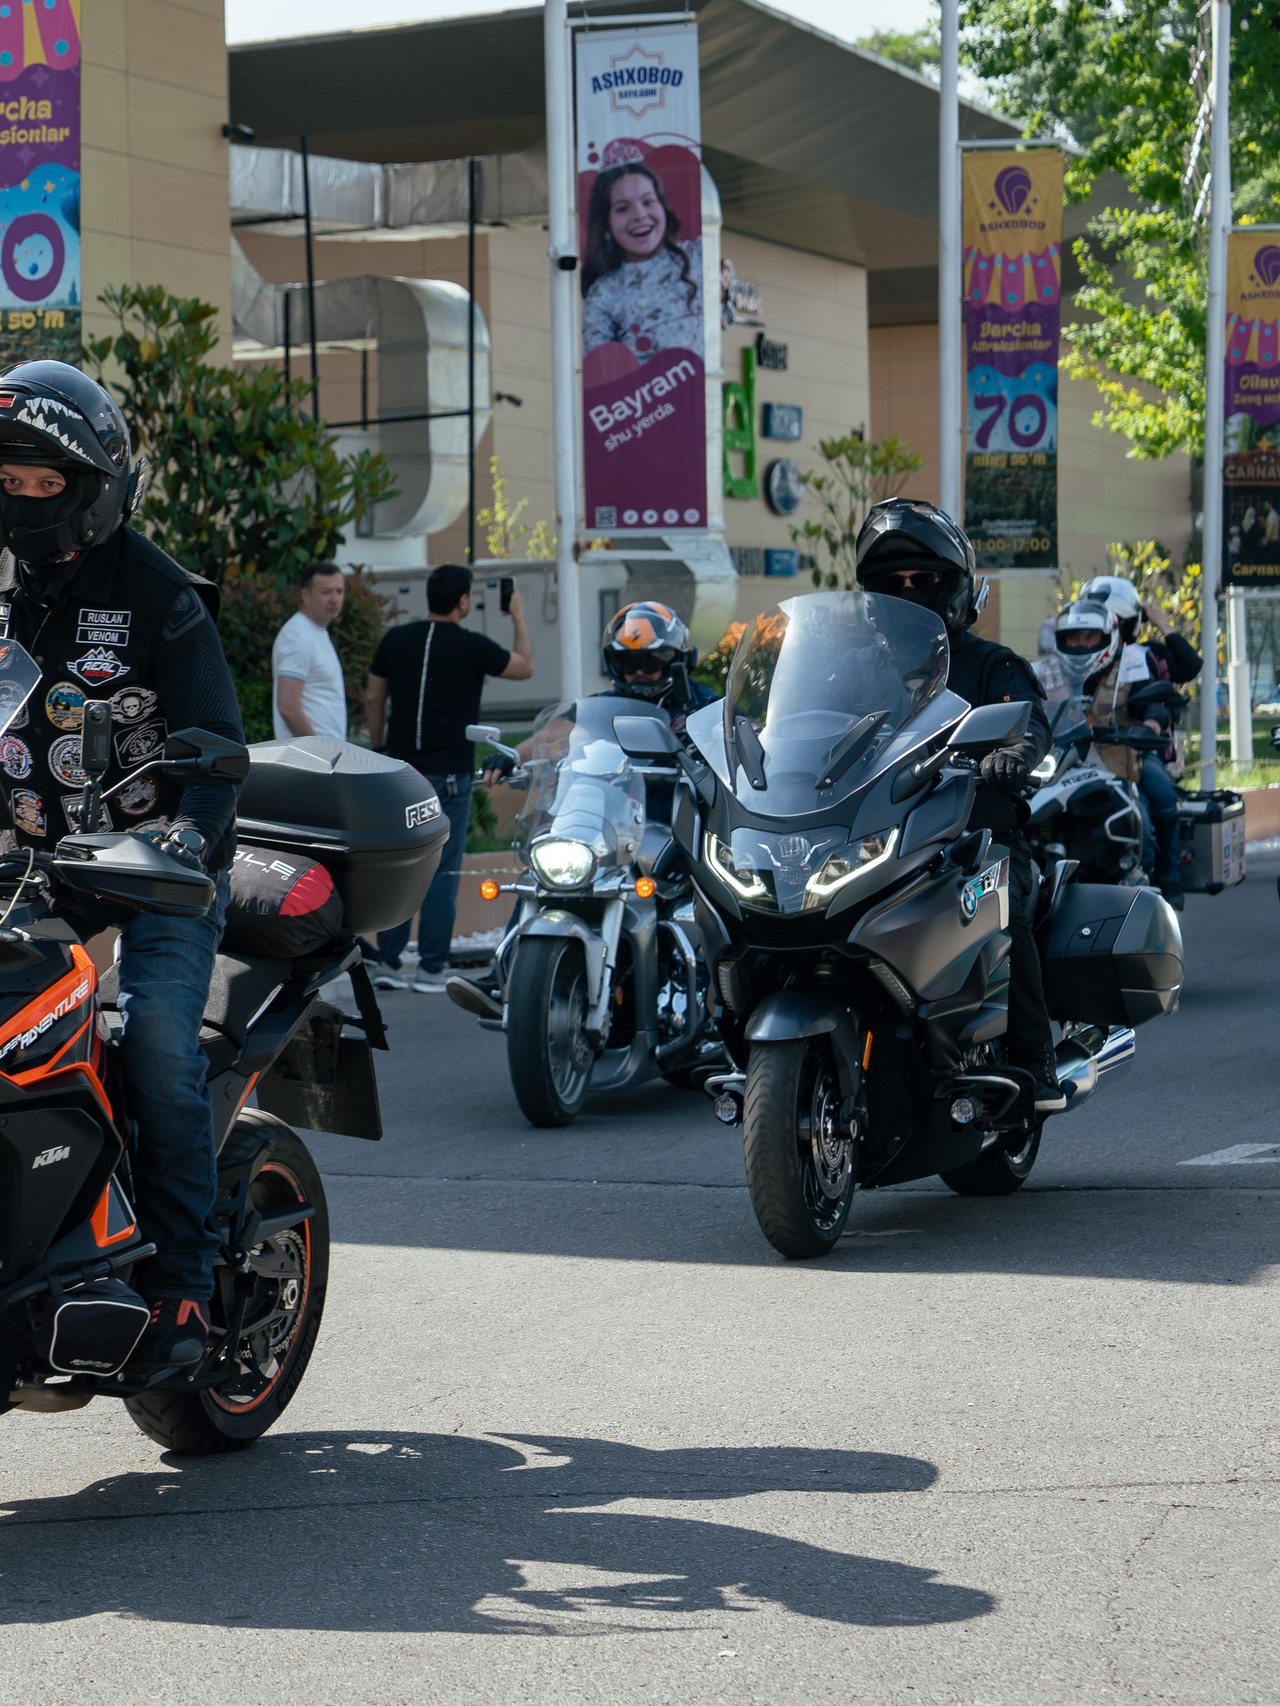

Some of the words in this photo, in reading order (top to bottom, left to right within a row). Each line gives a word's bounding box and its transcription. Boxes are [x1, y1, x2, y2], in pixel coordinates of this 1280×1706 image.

[591, 66, 683, 95] ASHXOBOD
[980, 320, 1042, 340] Barcha
[588, 359, 696, 433] Bayram
[604, 428, 633, 452] shu
[632, 402, 676, 438] yerda
[974, 392, 1047, 450] 70
[87, 612, 123, 624] RUSLAN
[87, 630, 119, 643] VENOM
[20, 979, 89, 1050] ADVENTURE
[32, 1145, 71, 1170] KTM
